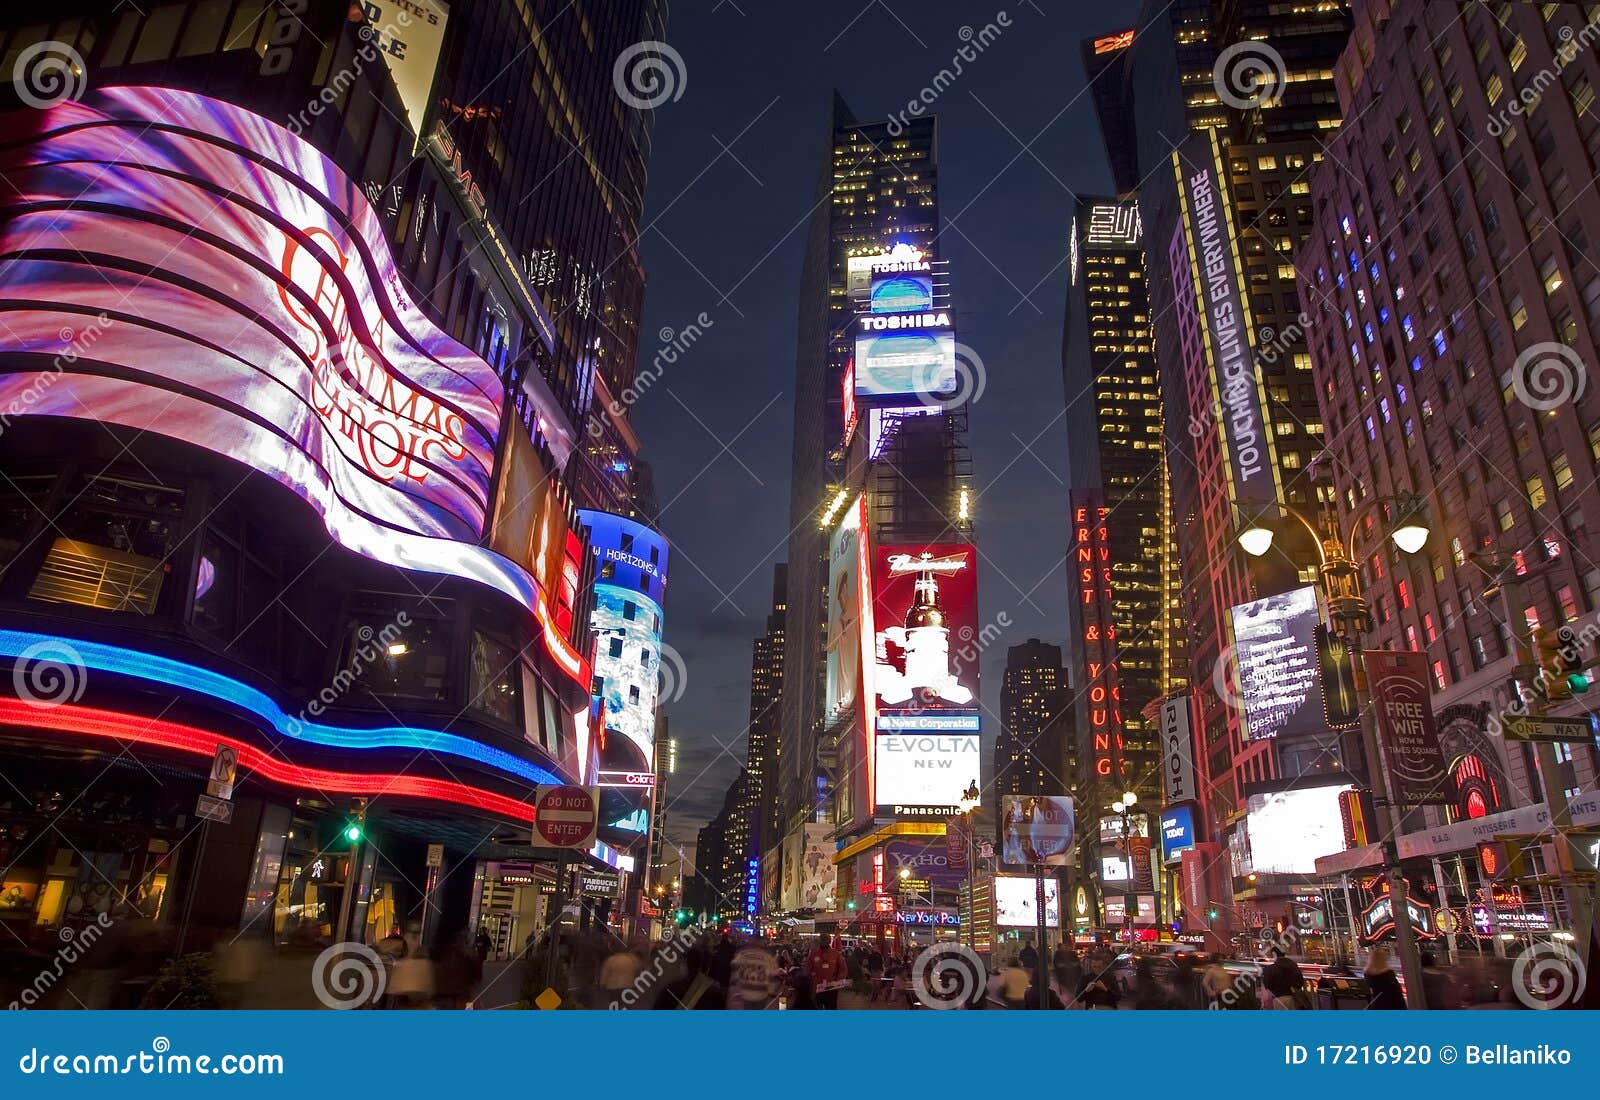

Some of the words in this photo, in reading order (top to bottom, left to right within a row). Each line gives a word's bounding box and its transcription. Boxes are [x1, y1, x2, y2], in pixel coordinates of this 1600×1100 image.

[1191, 169, 1230, 302] EVERYWHERE
[872, 261, 931, 273] TOSHIBA
[861, 313, 951, 331] TOSHIBA
[371, 314, 384, 352] A
[1214, 301, 1241, 362] LIVES
[1225, 362, 1261, 482] TOUCHING
[606, 549, 653, 574] HORIZONS
[1076, 508, 1094, 604] ERNST
[1086, 625, 1099, 640] &
[1385, 702, 1424, 718] FREE
[919, 718, 976, 731] Corporation
[1089, 663, 1111, 776] YOUNG
[1391, 720, 1425, 736] WIFI
[1516, 722, 1543, 734] ONE
[1553, 724, 1581, 736] WAY
[881, 737, 979, 753] EVOLTA
[1166, 704, 1183, 796] RICOH
[1412, 746, 1439, 755] SQUARE
[914, 759, 953, 769] NEW
[547, 797, 562, 807] DO
[566, 797, 586, 808] NOT
[895, 805, 962, 816] Panasonic
[547, 823, 582, 835] ENTER
[889, 852, 948, 868] YAHO
[583, 877, 618, 887] TARBUCKS
[585, 884, 611, 893] COFFEE
